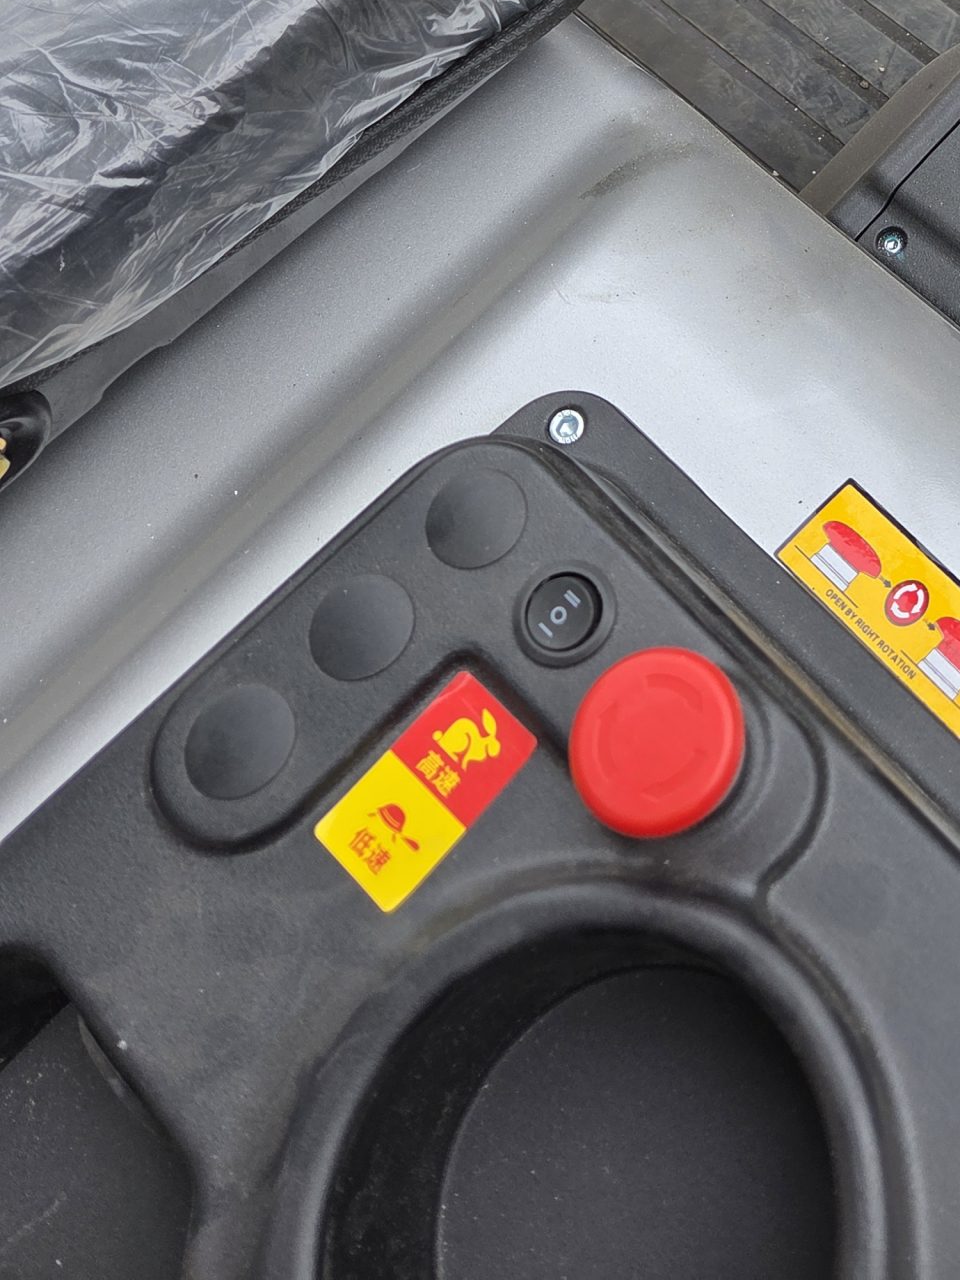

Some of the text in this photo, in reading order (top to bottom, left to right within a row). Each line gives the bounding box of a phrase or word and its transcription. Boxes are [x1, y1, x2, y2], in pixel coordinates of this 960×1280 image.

[825, 588, 917, 680] OPEN BY RIGHT ROTATION
[415, 749, 461, 799] 高速
[348, 827, 391, 876] 低速
